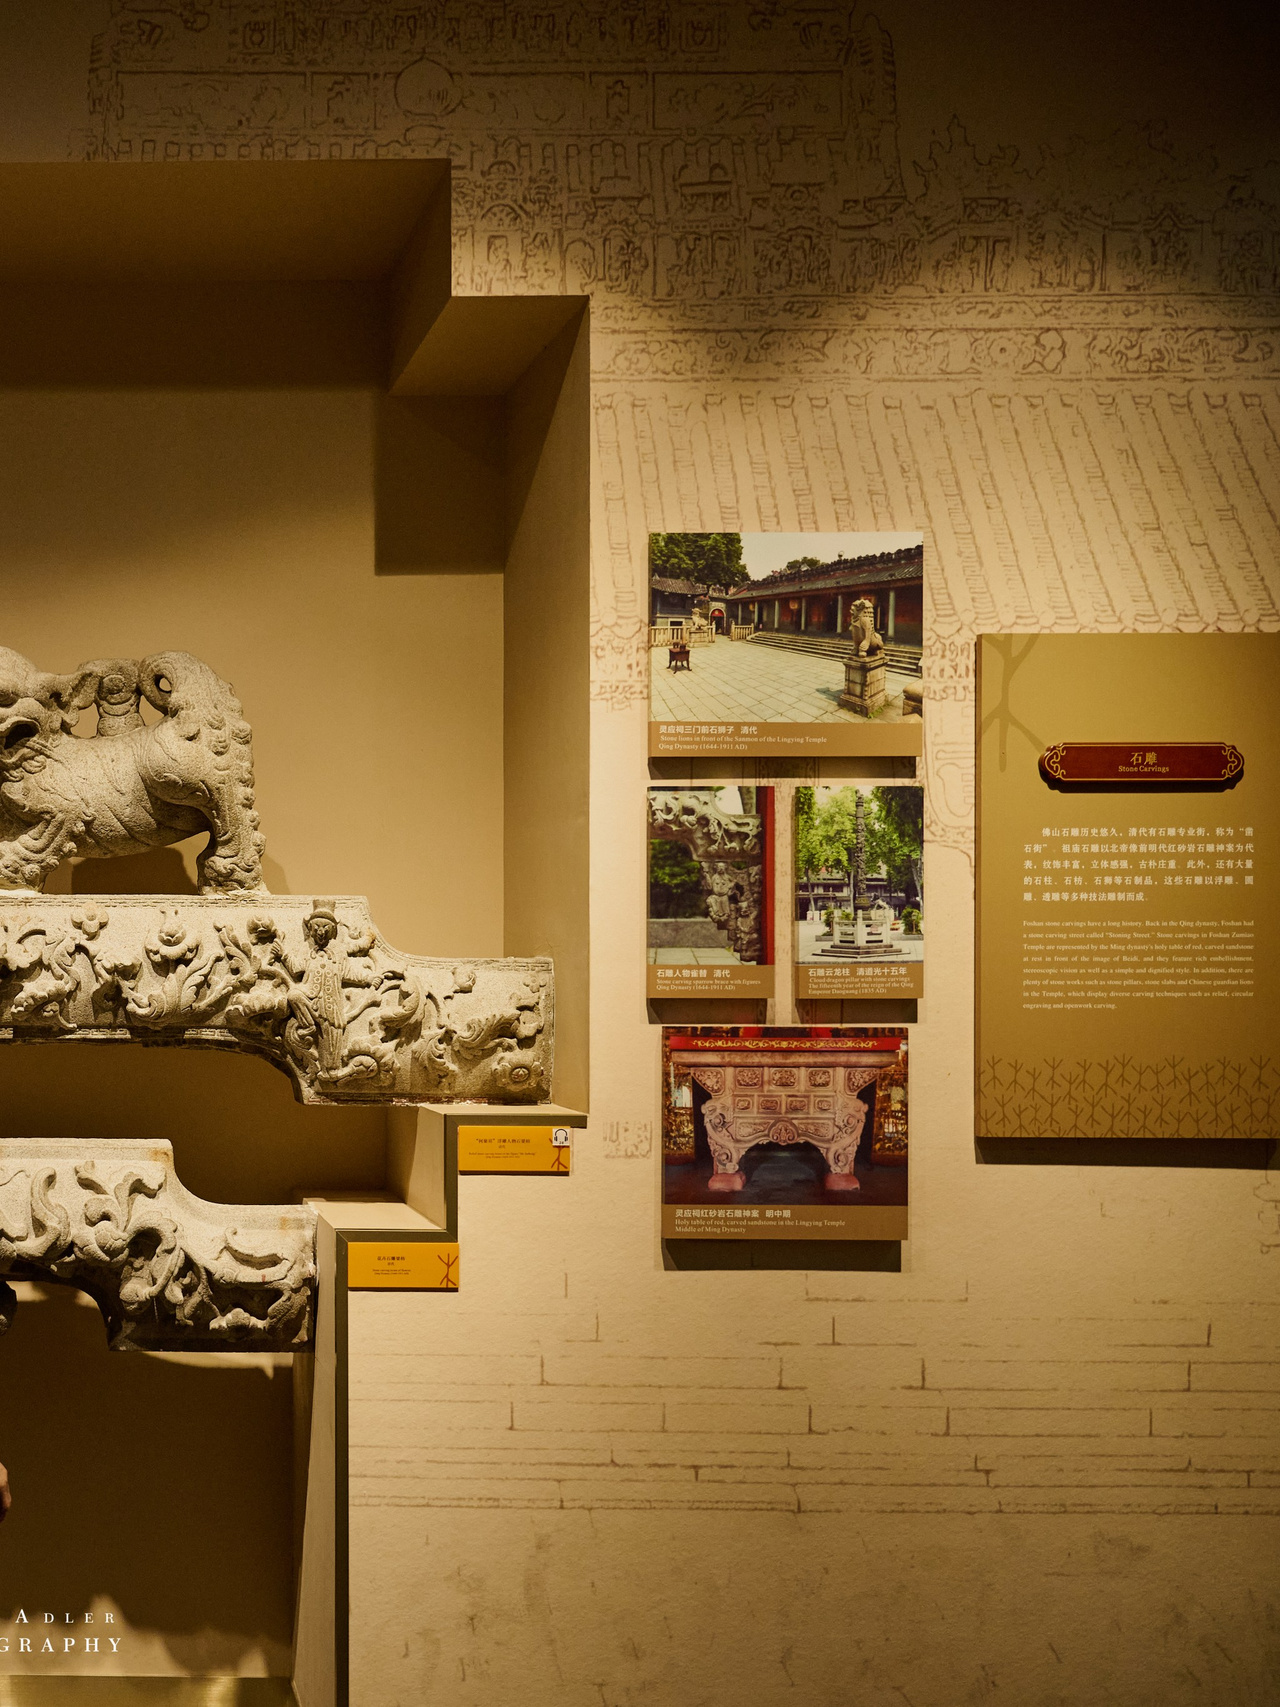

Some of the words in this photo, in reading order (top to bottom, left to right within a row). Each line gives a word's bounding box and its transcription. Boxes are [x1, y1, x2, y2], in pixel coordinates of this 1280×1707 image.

[740, 725, 758, 735] 清代
[1130, 752, 1157, 766] 石雕
[1139, 765, 1169, 774] Carvings
[713, 969, 730, 978] 清代
[856, 967, 907, 976] 清道光十五年
[765, 1209, 791, 1218] 明中期
